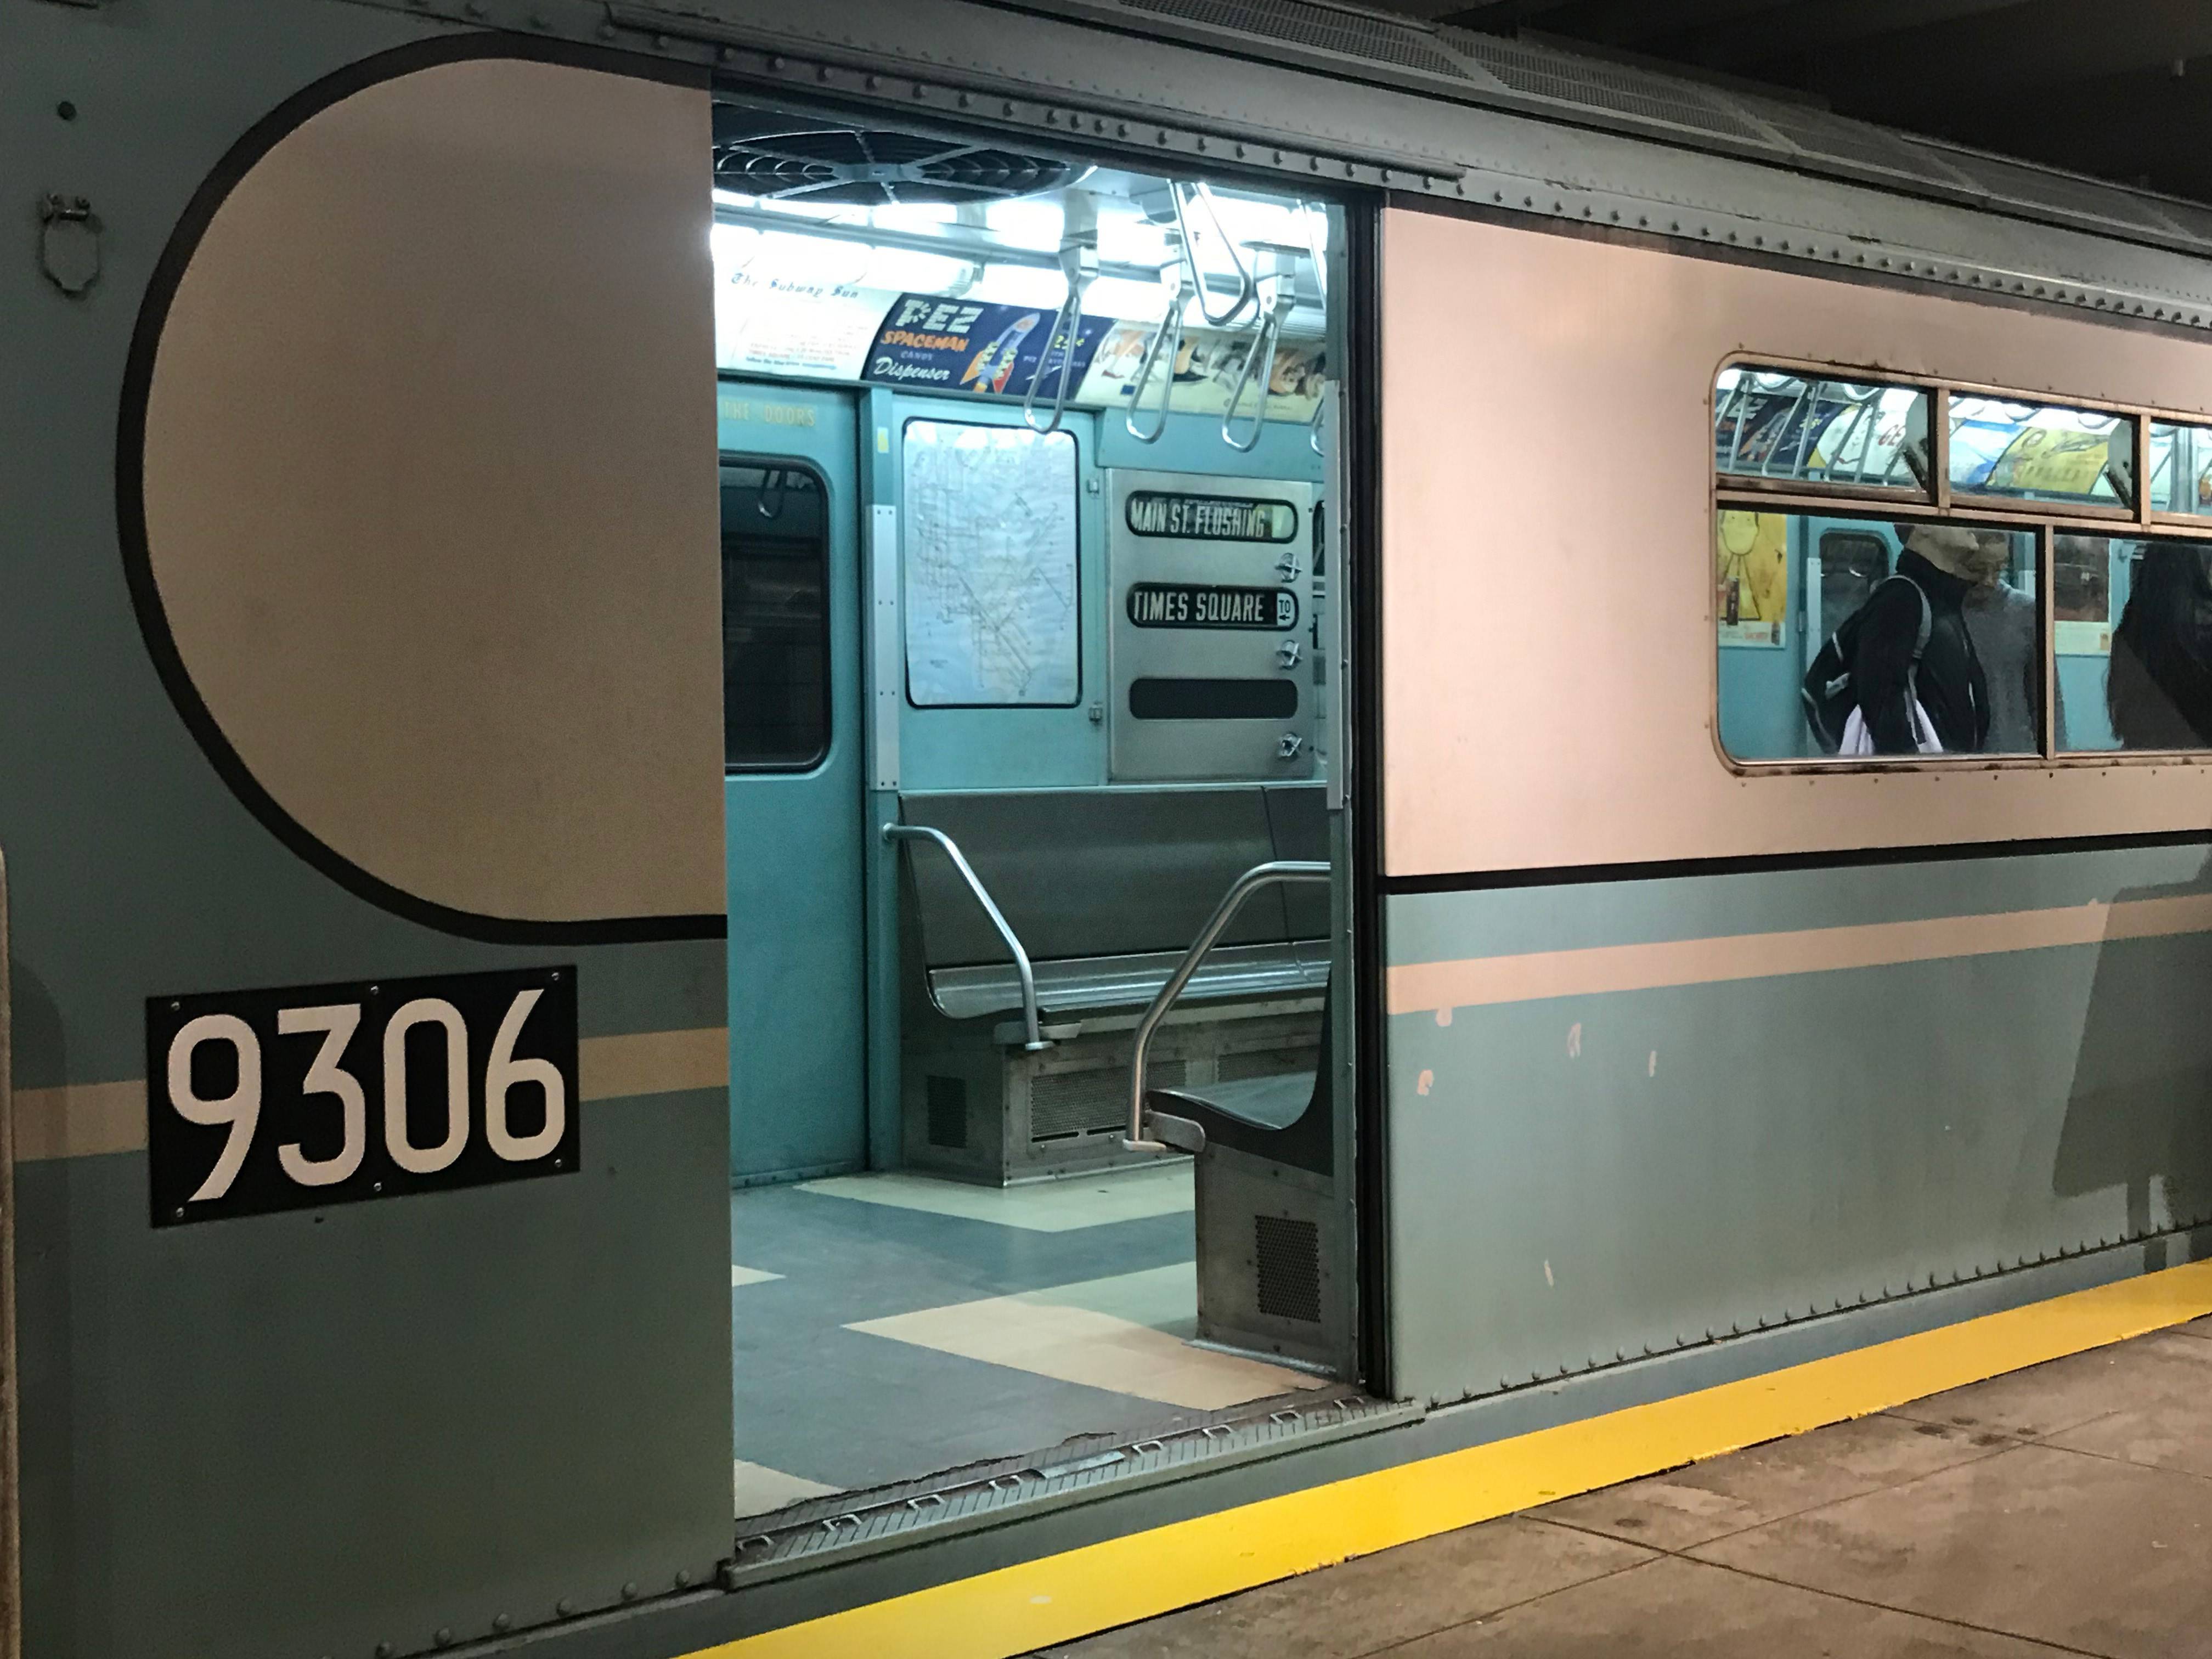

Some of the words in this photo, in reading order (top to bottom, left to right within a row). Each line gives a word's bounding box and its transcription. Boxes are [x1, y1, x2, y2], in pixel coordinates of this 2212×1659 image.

[769, 279, 823, 298] Subway
[831, 285, 858, 298] Sun
[895, 299, 984, 334] PEZ
[879, 330, 970, 352] SPACEMAN
[873, 356, 951, 381] Dispenser
[763, 404, 816, 427] DOORS
[1131, 498, 1167, 533] MAIN
[1170, 504, 1190, 534] ST.
[1194, 504, 1266, 538] FLUSHING
[1133, 591, 1188, 621] TIMES
[1196, 592, 1264, 622] SQUARE
[1278, 599, 1291, 613] TO
[167, 989, 565, 1203] 9306
